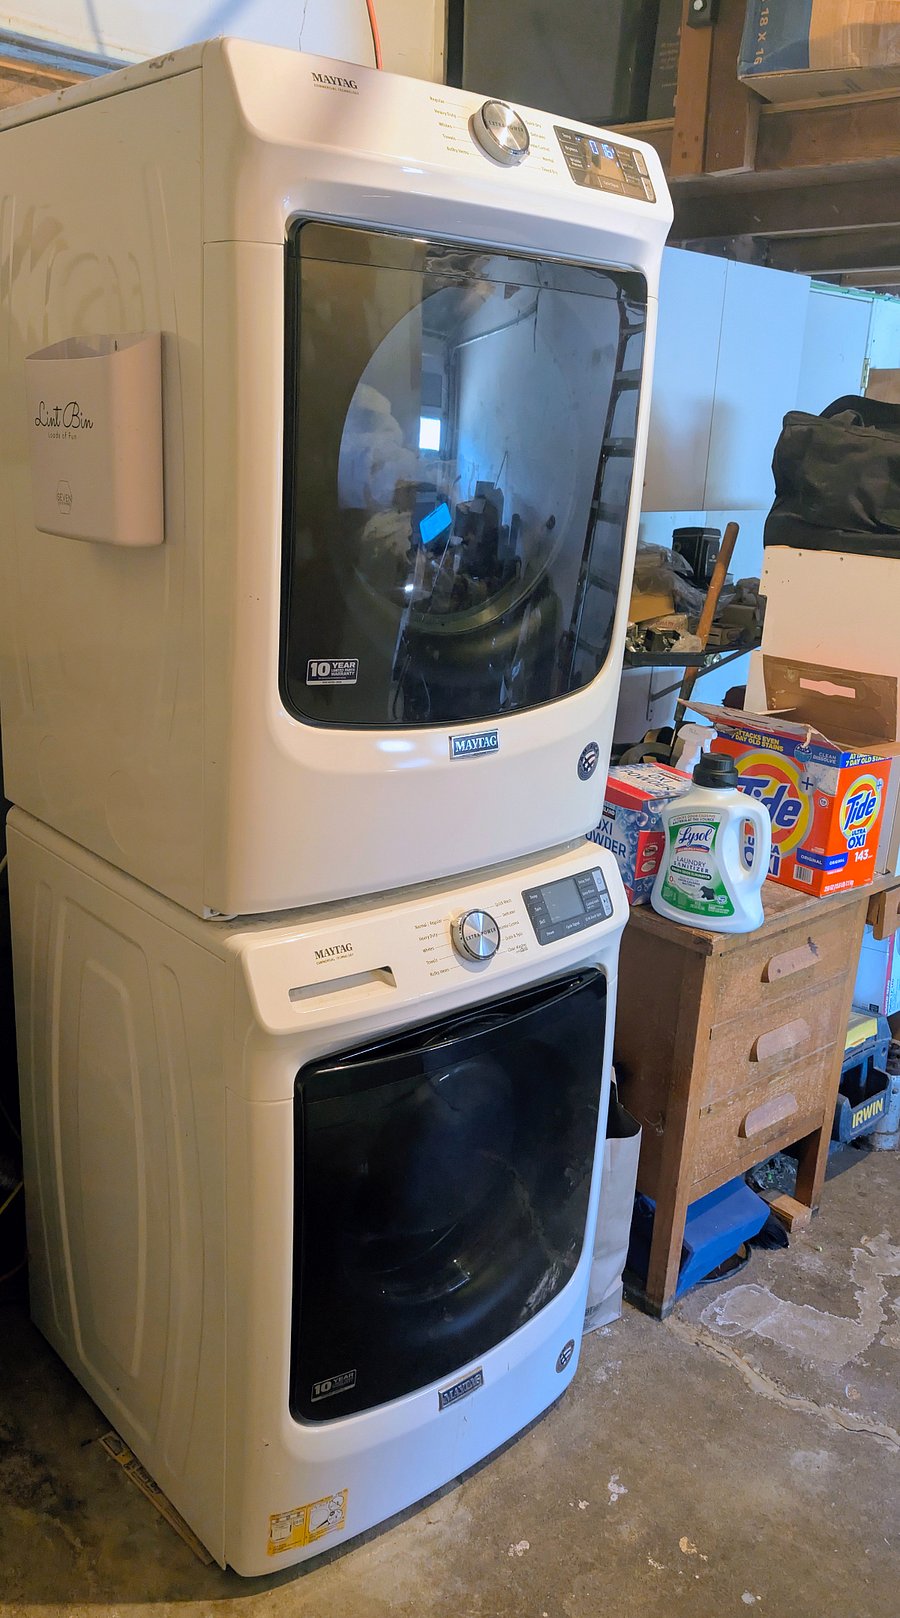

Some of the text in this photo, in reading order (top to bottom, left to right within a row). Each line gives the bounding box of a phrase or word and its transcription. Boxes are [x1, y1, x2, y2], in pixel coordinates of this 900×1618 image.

[753, 47, 765, 65] 16
[311, 72, 358, 89] MAYTAG
[35, 400, 94, 429] Lint Bin
[310, 661, 356, 677] 10 YEAR
[455, 735, 497, 752] MAYTAG
[735, 734, 784, 752] DAY OLD STAINS
[762, 736, 780, 746] EVEN
[818, 751, 837, 760] CLEAN
[845, 760, 850, 768] 7
[850, 758, 860, 766] DAY
[861, 756, 872, 764] OLD
[844, 791, 877, 830] Tide
[678, 826, 713, 847] Lysol
[851, 828, 866, 836] ULTRA
[847, 834, 866, 849] OXI
[676, 856, 707, 868] LAUNDRY
[800, 854, 823, 865] ORIGINAL
[854, 848, 870, 863] 143
[673, 860, 709, 873] SANITIZER
[465, 927, 497, 941] EXTRA POWER
[314, 942, 353, 960] MAYTAG
[852, 1097, 884, 1129] IRWIN
[314, 1381, 332, 1395] 10
[333, 1372, 354, 1384] YEAR
[443, 1374, 481, 1404] MAYTAG
